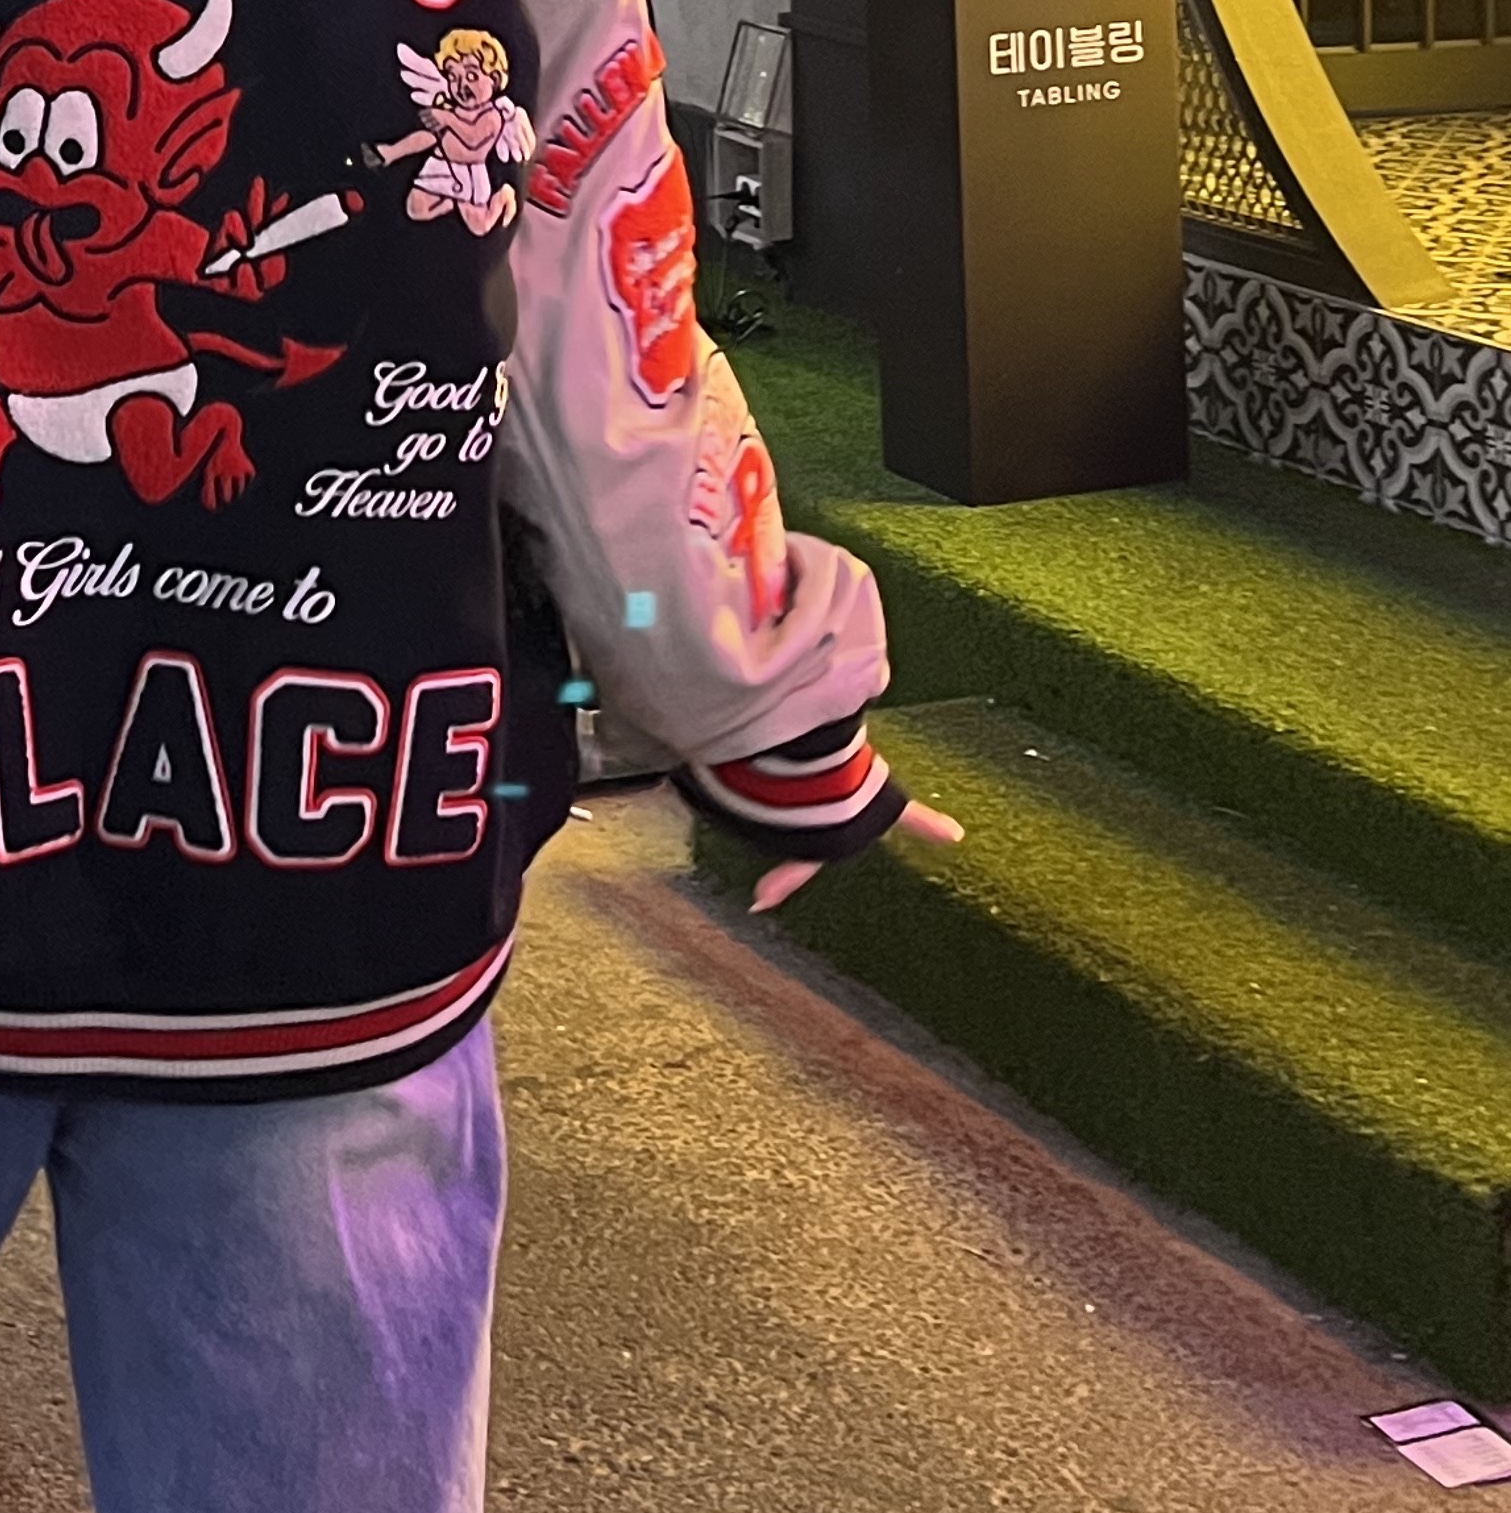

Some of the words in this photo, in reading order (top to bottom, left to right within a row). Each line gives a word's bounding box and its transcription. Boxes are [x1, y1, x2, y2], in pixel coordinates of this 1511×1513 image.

[989, 20, 1145, 76] 테이블링
[1017, 81, 1122, 108] TABLING
[365, 361, 488, 426] Good
[384, 432, 446, 476] go
[458, 416, 493, 462] to
[294, 469, 457, 520] Heaven
[13, 535, 141, 627] Girls
[153, 561, 275, 616] come
[283, 565, 336, 625] to
